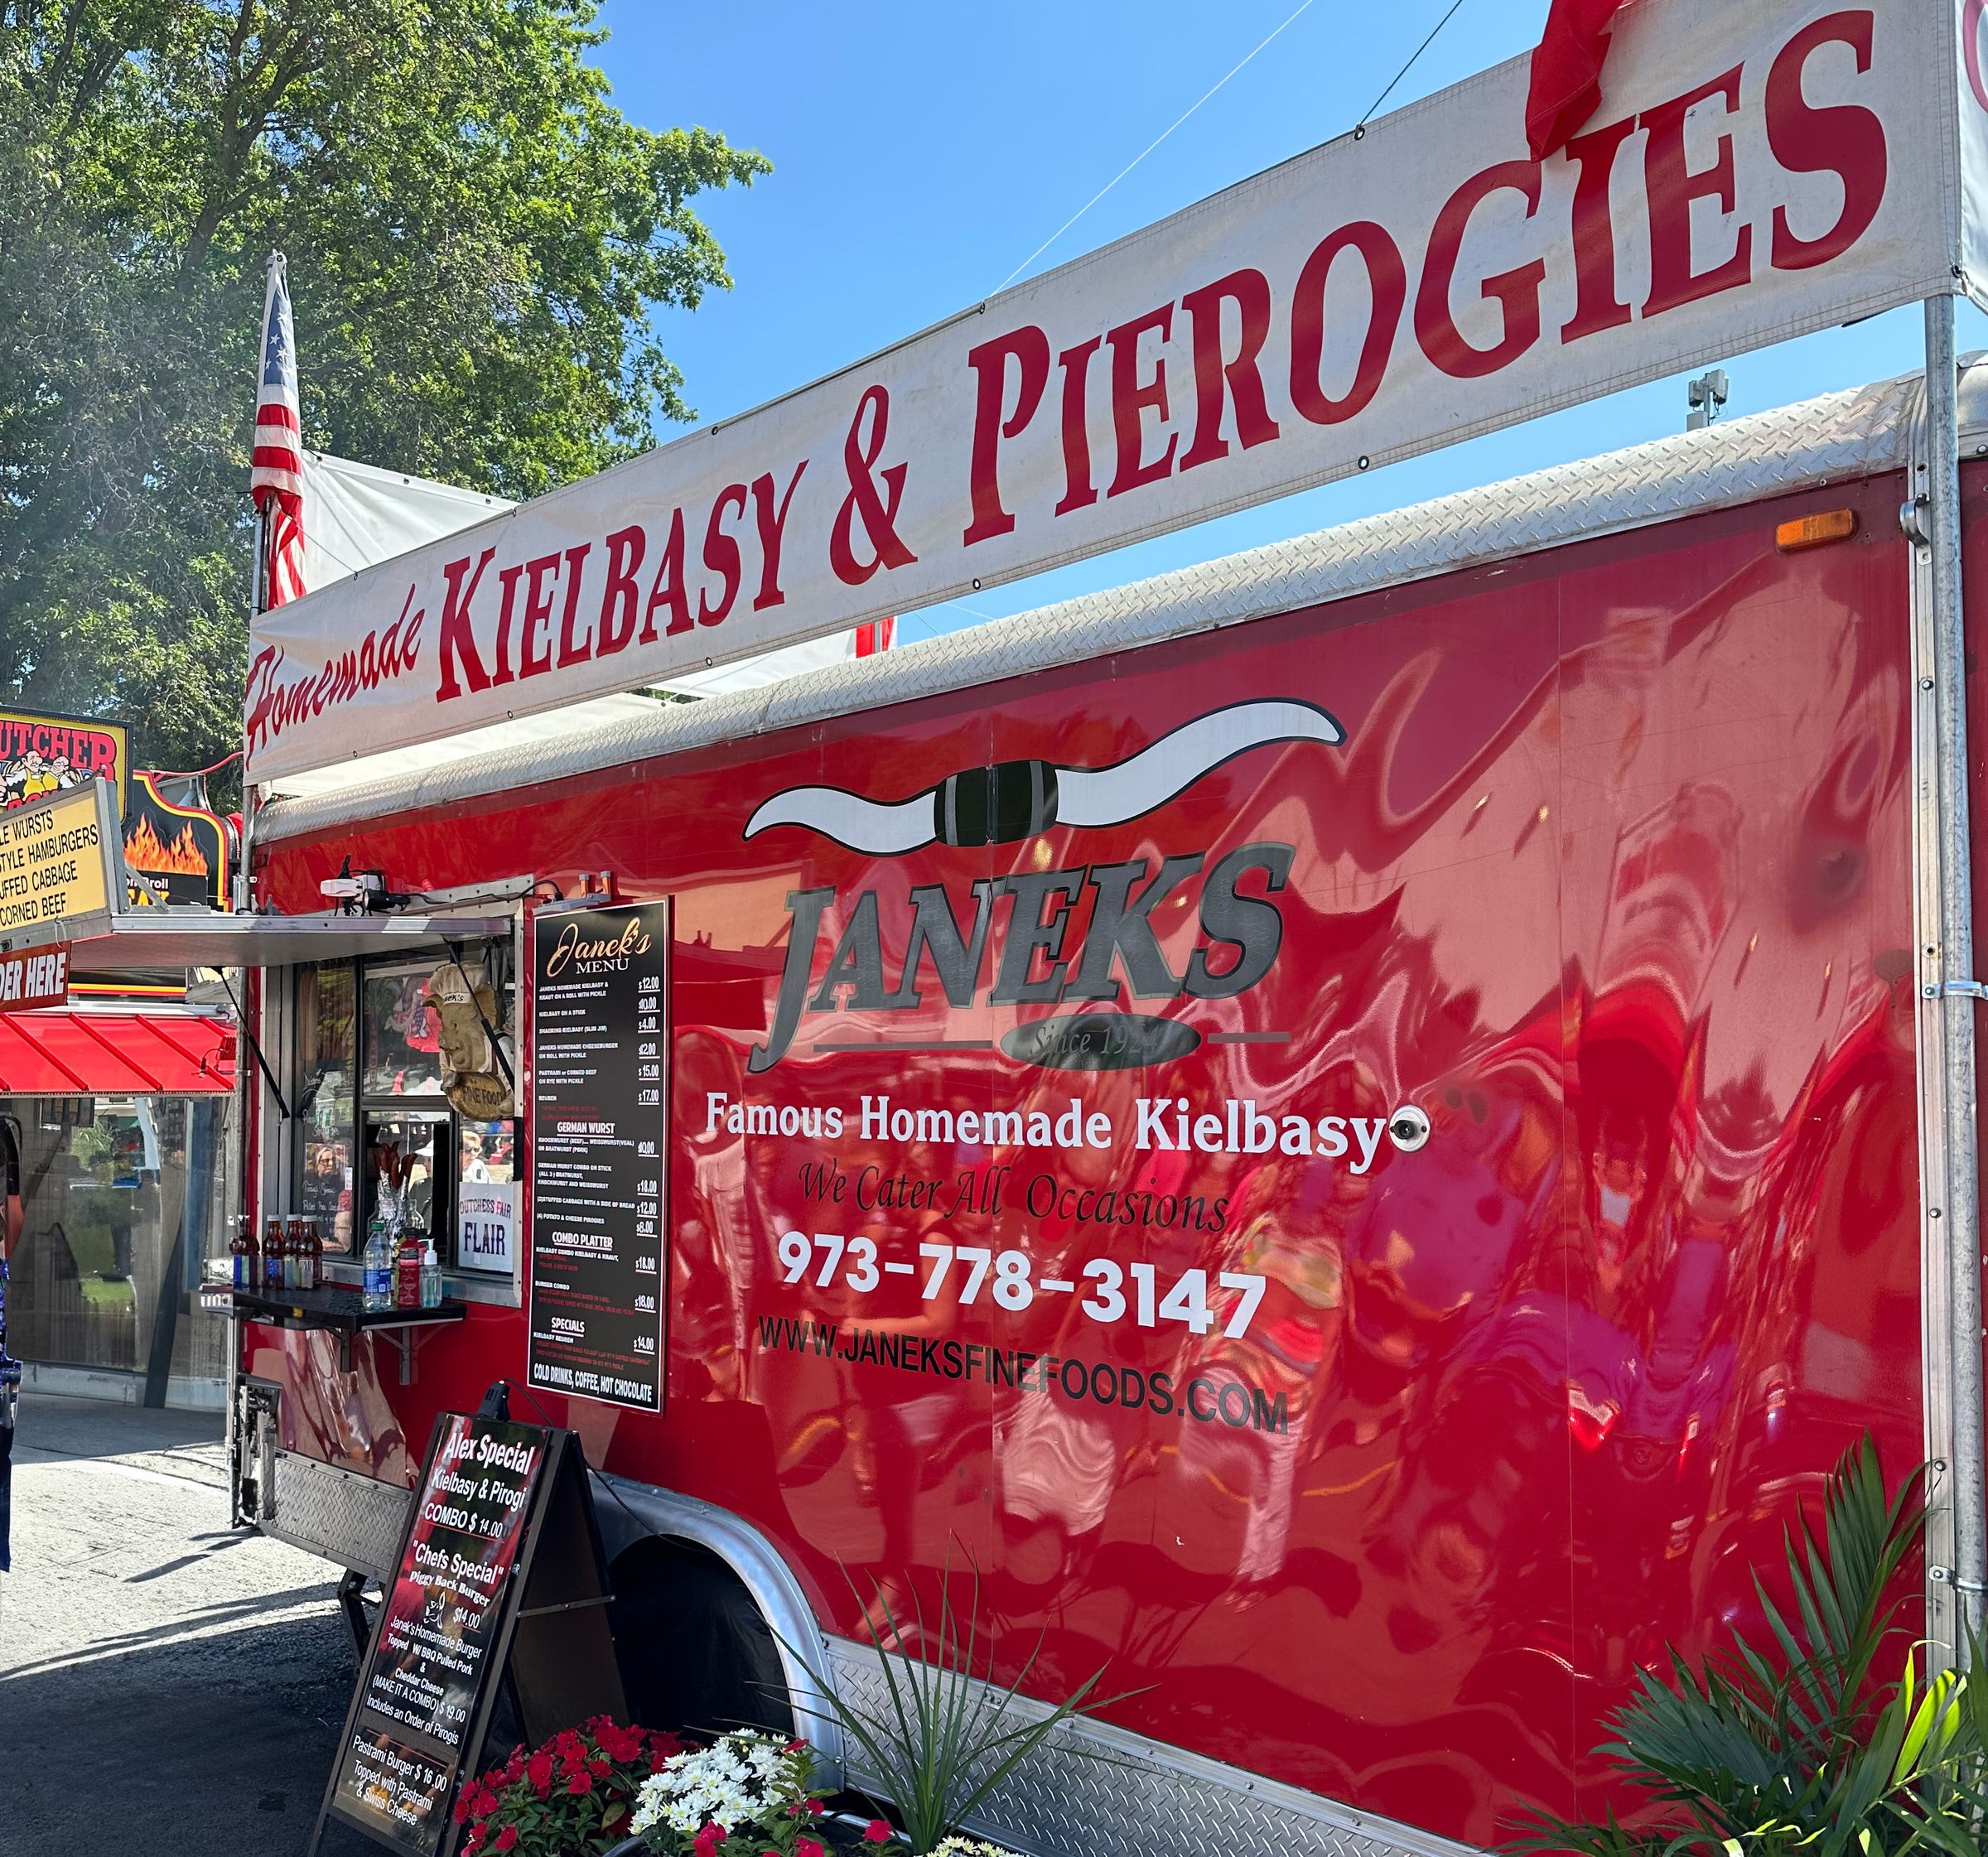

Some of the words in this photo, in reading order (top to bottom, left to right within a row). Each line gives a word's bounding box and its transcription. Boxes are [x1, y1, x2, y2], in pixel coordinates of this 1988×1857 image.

[244, 583, 425, 771] Homemade
[436, 458, 810, 703] KIELBASY
[829, 383, 919, 586] &
[963, 10, 1888, 547] PIEROGIES
[12, 809, 53, 841] WURSTS
[0, 848, 25, 873] TYLE
[27, 823, 99, 864] HAMBURGERS
[31, 860, 78, 891] CABBAGE
[0, 900, 38, 926] CORNED
[41, 892, 66, 916] BEEF
[547, 916, 652, 977] Janek's
[746, 842, 1296, 1074] JANEKS
[25, 952, 66, 998] HERE
[576, 957, 630, 974] MENU
[1029, 1024, 1091, 1058] Since
[557, 1121, 587, 1133] GERMAN
[588, 1122, 615, 1134] WURST
[706, 1092, 843, 1139] Famous
[860, 1096, 1112, 1149] Homemade
[1135, 1097, 1387, 1174] Kielbasy
[637, 1179, 657, 1194] $18.00
[799, 1158, 847, 1204] We
[856, 1165, 943, 1212] Cater
[943, 1165, 1011, 1219] All
[1027, 1174, 1231, 1232] Occasions
[460, 1199, 495, 1215] DUTCHESS
[497, 1201, 512, 1219] FAIR
[636, 1201, 657, 1216] $12.00
[464, 1222, 505, 1256] FLAIR
[552, 1232, 579, 1244] COMBO
[580, 1233, 613, 1248] PLATTER
[636, 1220, 654, 1234] $8.00
[635, 1256, 655, 1271] $18.00
[635, 1295, 654, 1310] $18.00
[779, 1230, 1267, 1339] 973-778-3147
[551, 1317, 585, 1333] SPECIALS
[533, 1363, 550, 1381] COLD
[550, 1365, 574, 1389] DRINKS,
[575, 1371, 599, 1394] COFFEE,
[601, 1375, 614, 1394] HOT
[615, 1378, 652, 1402] CHOCOLATE
[759, 1314, 1289, 1435] WWW.JANEKSFINEFOODS.COM
[443, 1432, 478, 1459] Alex
[476, 1434, 536, 1475] Special
[431, 1468, 478, 1502] Kielbasy
[478, 1478, 489, 1500] &
[489, 1481, 528, 1512] Pirogi
[424, 1502, 468, 1529] COMBO
[413, 1540, 449, 1570] "Chefs
[451, 1553, 504, 1584] Special"
[434, 1575, 458, 1591] Back
[458, 1582, 490, 1607] Burger
[453, 1607, 480, 1629] $14.00
[388, 1633, 410, 1651] Topped
[421, 1647, 437, 1662] BBQ
[436, 1652, 458, 1670] Pulled
[456, 1660, 473, 1676] Pork
[390, 1615, 416, 1636] Janek's
[414, 1623, 455, 1649] Homemade
[456, 1638, 483, 1660] Burger
[395, 1667, 421, 1686] Cheddar
[421, 1678, 445, 1696] Cheese
[420, 1662, 426, 1673] &
[372, 1674, 396, 1695] (MAKE
[394, 1681, 404, 1696] IT
[402, 1686, 408, 1700] A
[408, 1689, 439, 1713] COMBO)
[366, 1693, 394, 1716] Includes
[393, 1708, 404, 1720] an
[404, 1710, 426, 1730] Order
[424, 1720, 434, 1734] of
[433, 1723, 459, 1746] Pirogis
[352, 1735, 388, 1763] Pastrami
[386, 1751, 415, 1777] Burger
[354, 1760, 381, 1785] Topped
[381, 1773, 397, 1794] with
[397, 1782, 434, 1811] Pastrami
[356, 1783, 363, 1798] &
[364, 1787, 386, 1810] Swiss
[387, 1798, 417, 1826] Cheese
